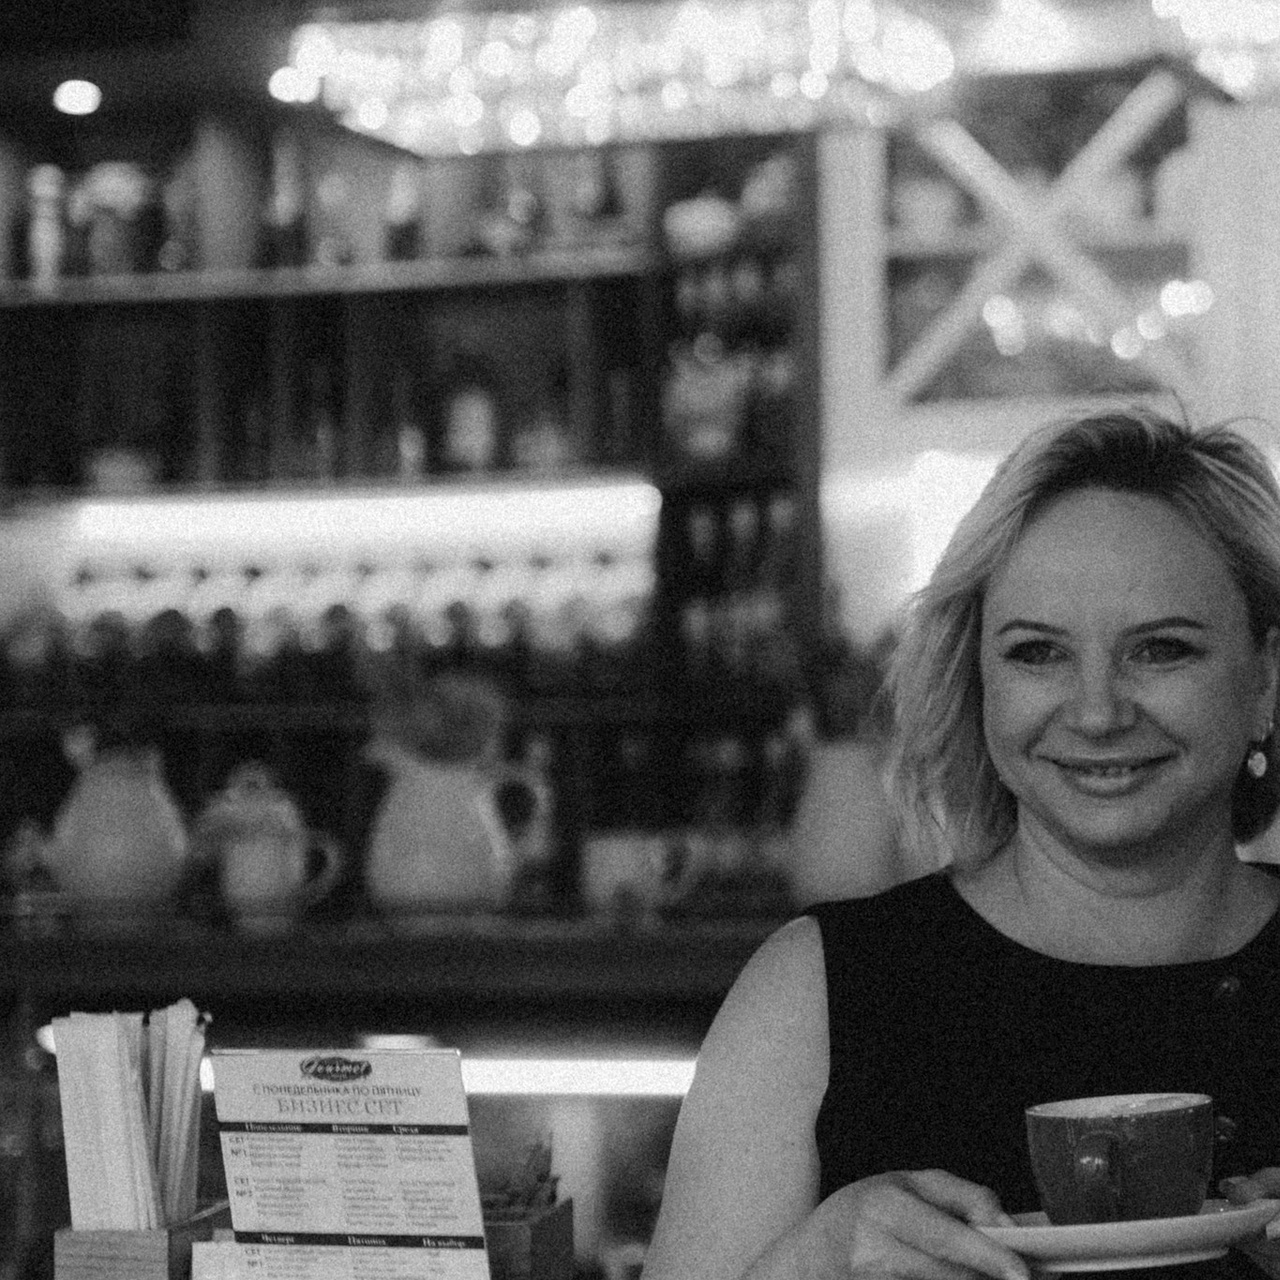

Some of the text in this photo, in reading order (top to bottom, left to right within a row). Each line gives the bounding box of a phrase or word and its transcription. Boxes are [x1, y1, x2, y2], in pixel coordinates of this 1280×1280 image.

[262, 1084, 350, 1097] ПОНЕДЕЛЬНИКА
[352, 1085, 370, 1096] ПО
[372, 1085, 421, 1097] ПЯТНИЦУ
[277, 1098, 403, 1116] БИЗНЕС СЕТ
